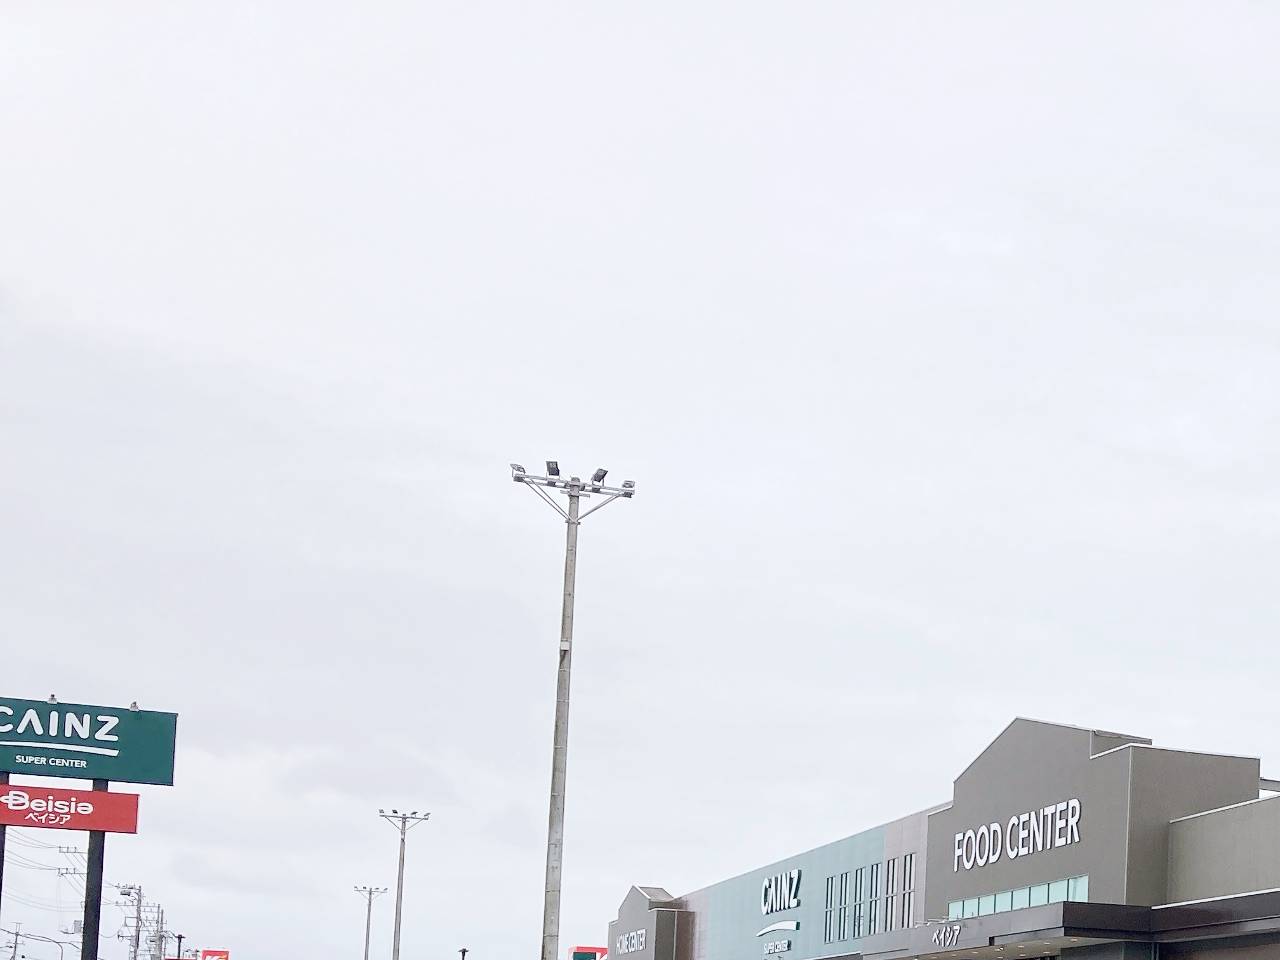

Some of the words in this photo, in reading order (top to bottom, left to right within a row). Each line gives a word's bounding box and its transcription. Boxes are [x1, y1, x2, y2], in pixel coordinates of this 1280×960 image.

[15, 755, 47, 766] SUPER
[49, 757, 87, 769] CENTER
[0, 790, 94, 815] Beisia
[25, 812, 71, 825] ベイシア
[953, 822, 1003, 873] FOOD
[1006, 798, 1082, 860] CENTER
[761, 869, 801, 915] CAINZ
